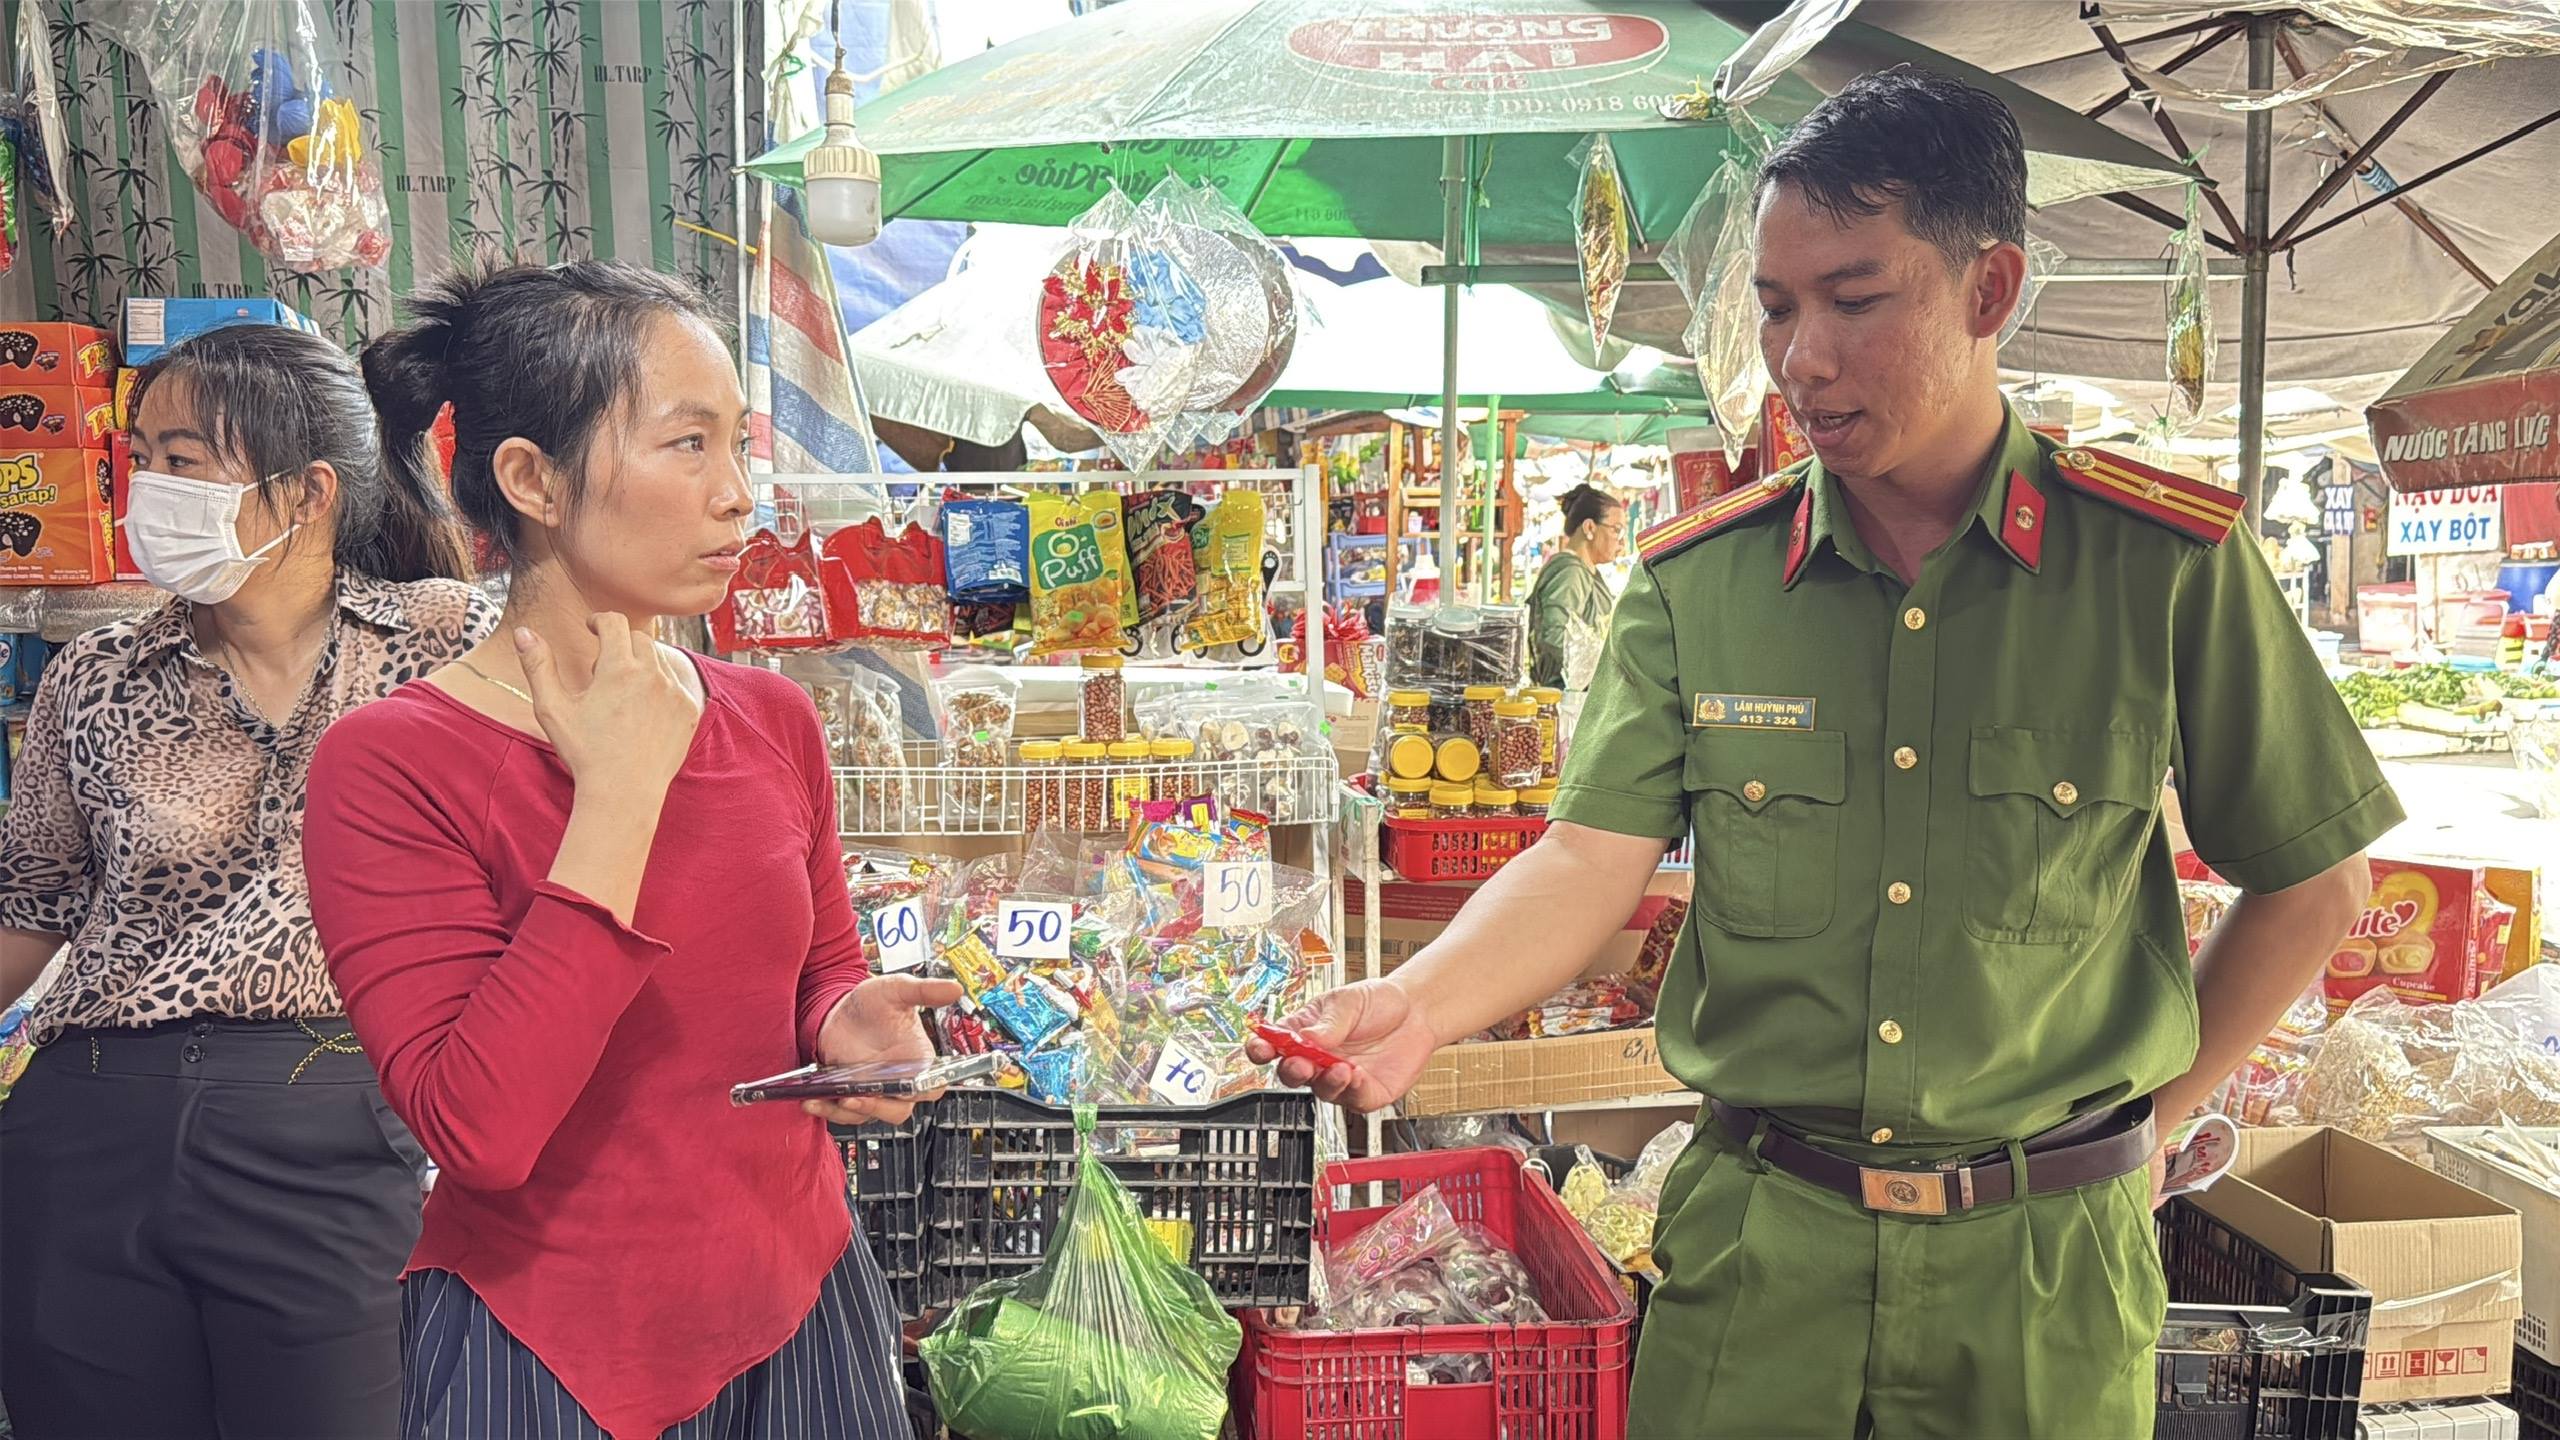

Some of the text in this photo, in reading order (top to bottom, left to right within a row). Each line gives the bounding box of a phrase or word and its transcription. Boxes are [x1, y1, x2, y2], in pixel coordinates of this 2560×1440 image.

[1561, 96, 1624, 112] 0918
[2384, 426, 2448, 462] NƯỚC
[2401, 512, 2491, 546] XAY BỘT
[1041, 545, 1099, 587] Puff
[1740, 715, 1763, 724] 413
[1774, 716, 1797, 725] 324
[1220, 867, 1262, 913] 50
[877, 906, 918, 948] 60
[1008, 910, 1062, 947] 50
[2393, 976, 2436, 991] Cupcake
[1164, 1049, 1207, 1094] 70
